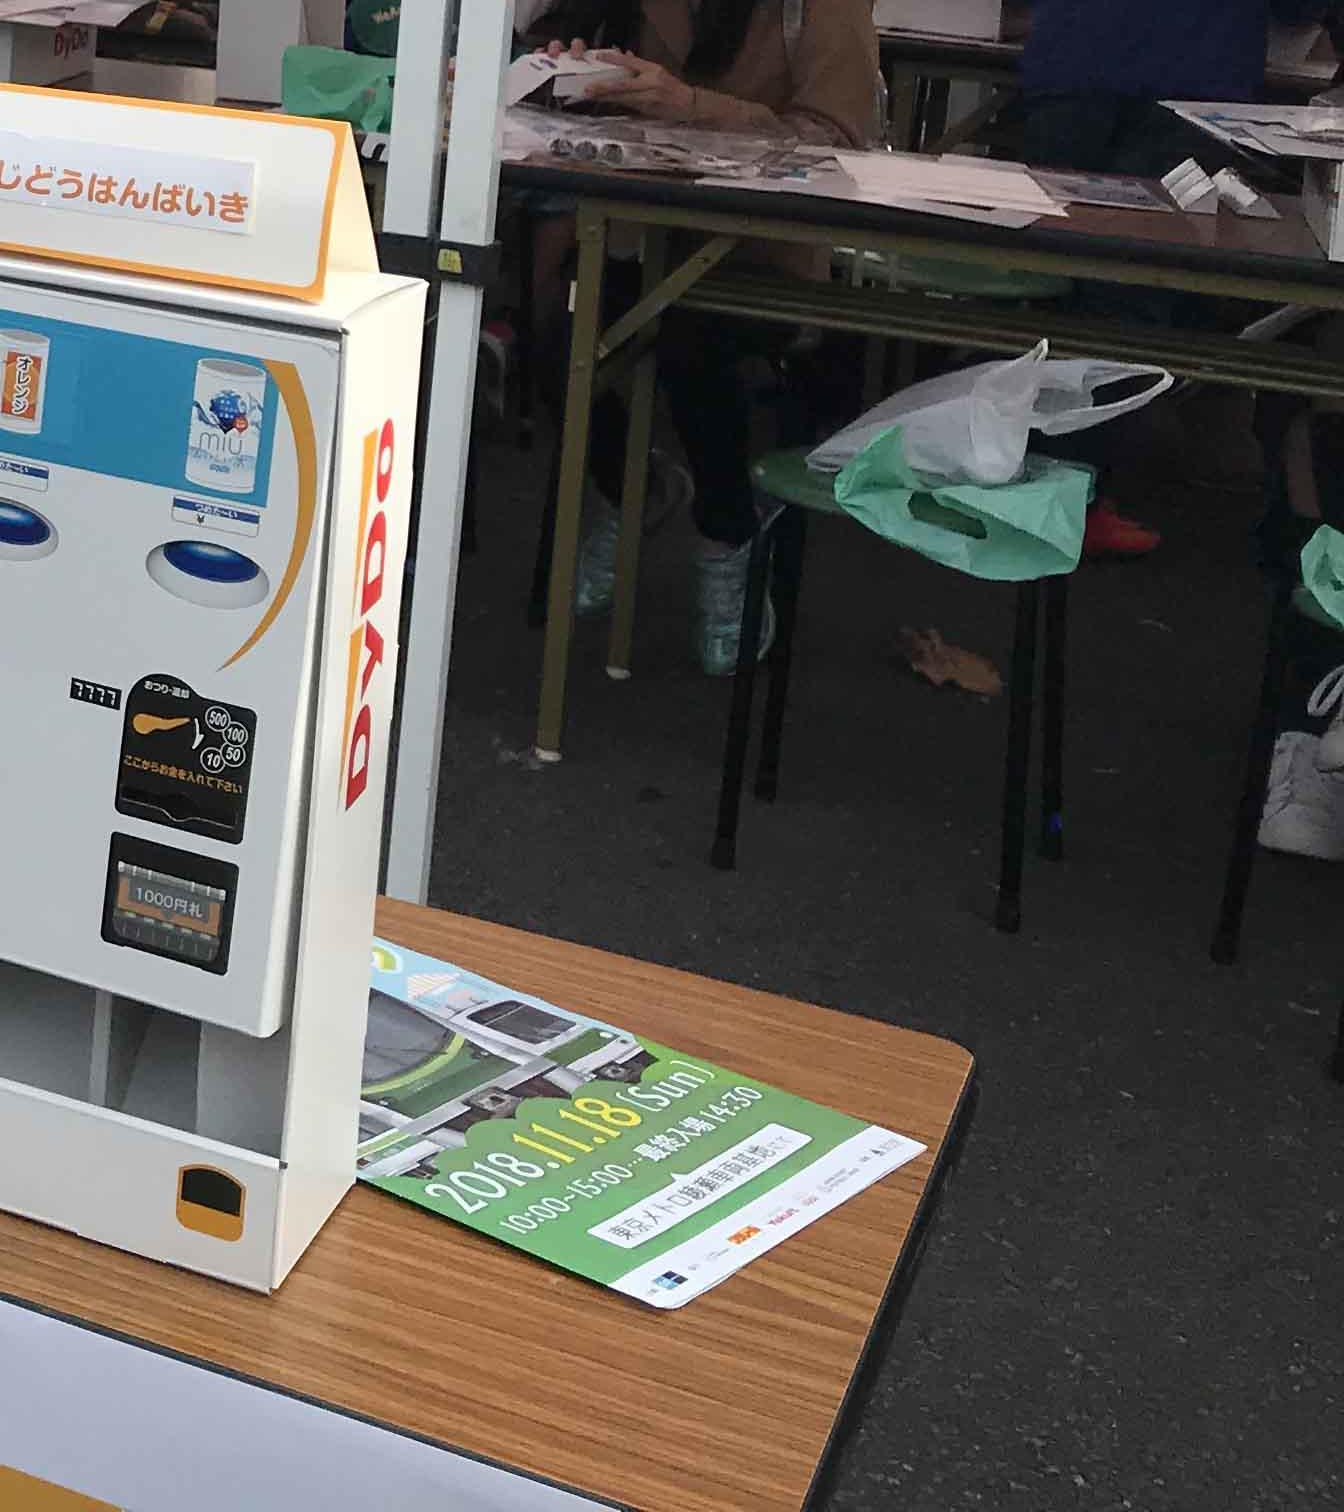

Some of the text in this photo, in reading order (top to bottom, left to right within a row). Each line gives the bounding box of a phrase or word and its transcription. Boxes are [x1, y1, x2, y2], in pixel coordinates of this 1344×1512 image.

[13, 356, 32, 414] オレンジ
[344, 417, 395, 812] DyDo
[73, 681, 117, 706] 7777
[209, 711, 227, 728] 500
[227, 726, 245, 743] 100
[206, 752, 221, 768] 10
[225, 747, 241, 763] 50
[136, 887, 204, 918] 1000円札
